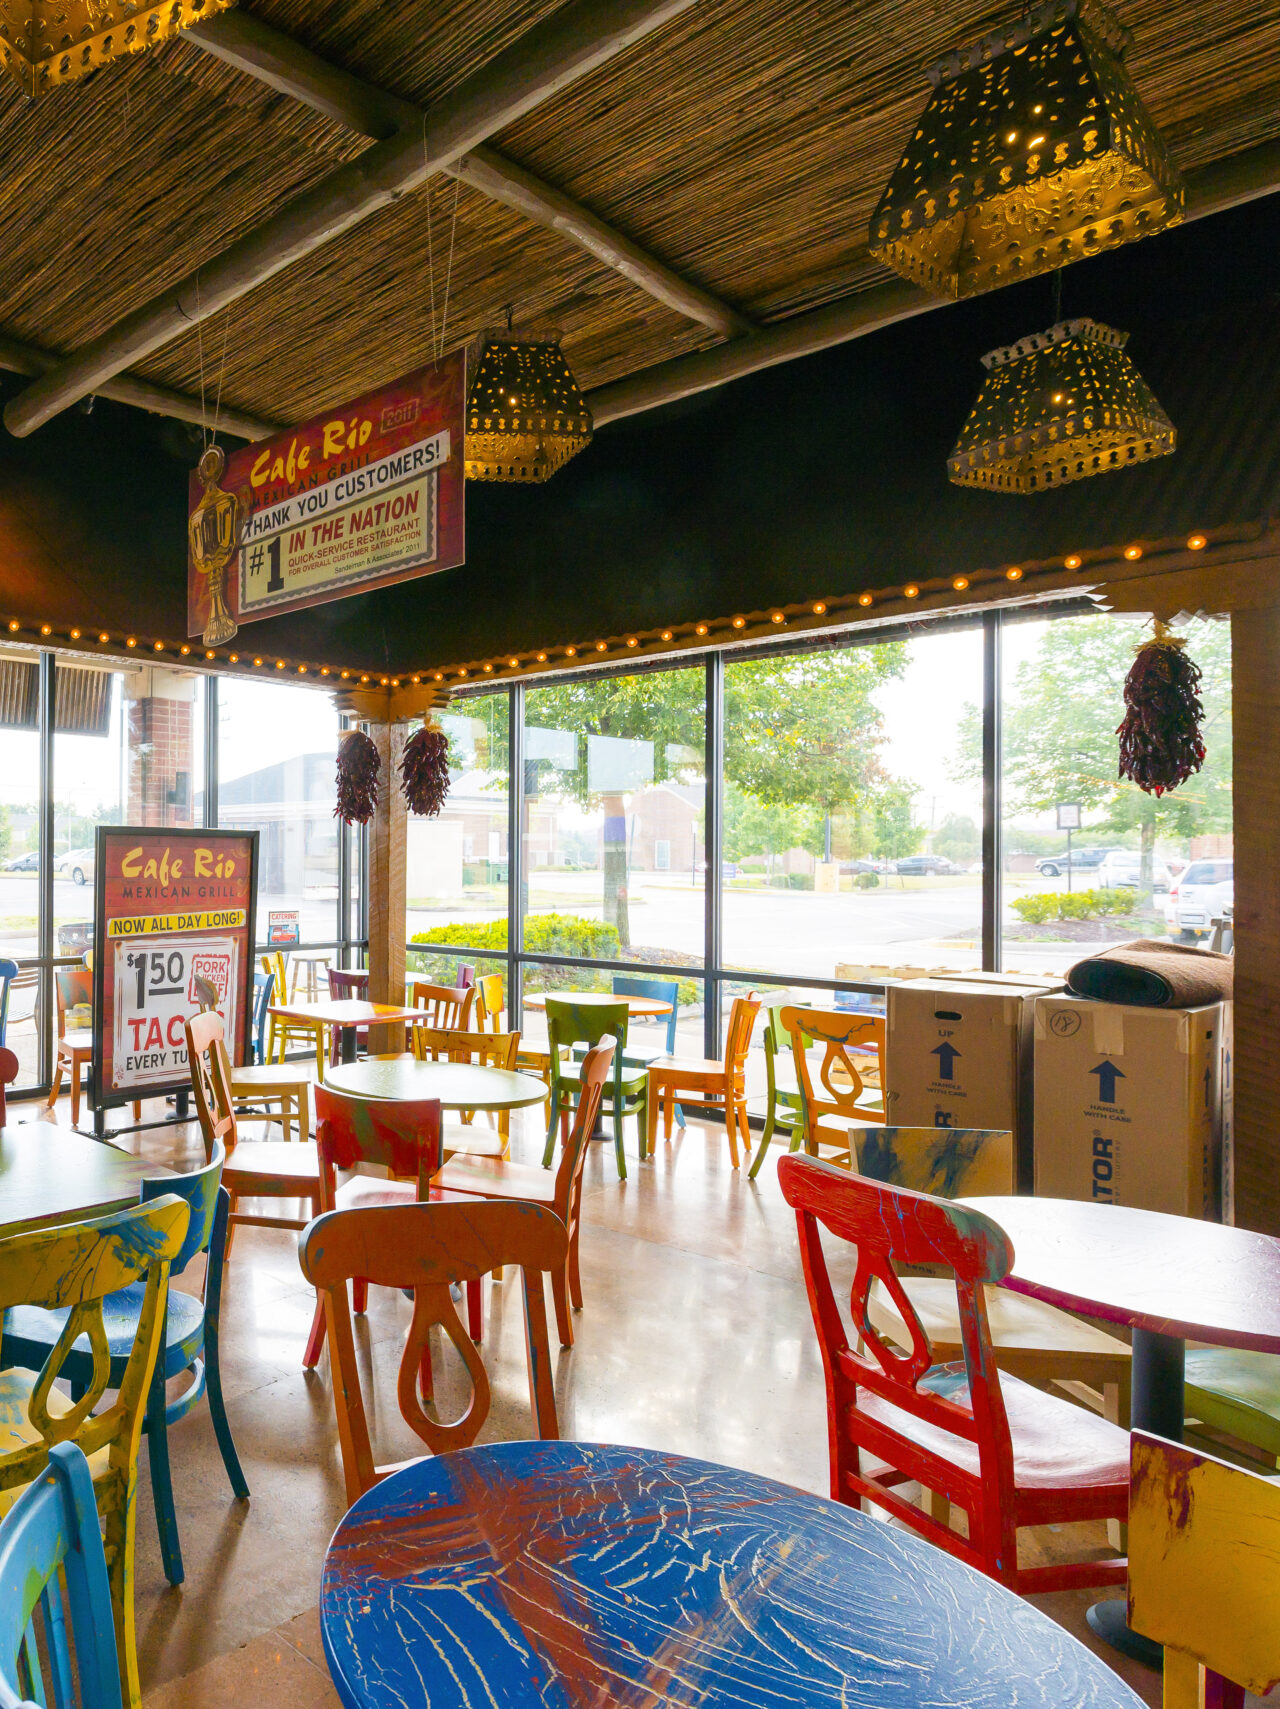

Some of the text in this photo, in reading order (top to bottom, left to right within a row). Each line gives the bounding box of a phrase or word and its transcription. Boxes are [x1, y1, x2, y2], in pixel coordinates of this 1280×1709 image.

[250, 417, 372, 488] Cafe Rio
[245, 439, 440, 538] THANK YOU CUSTOMERS!
[253, 453, 370, 506] MEXICAN GRILL
[288, 490, 419, 553] IN THE NATION
[288, 517, 420, 568] QUICK-SERVICE RESTAURANT
[288, 530, 421, 577] FOR OVERALL CUSTOMER SATISFACTION
[121, 847, 236, 887] Cafe Rio
[122, 886, 235, 899] MEXICAN GRILL
[114, 911, 240, 934] NOW ALL DAY LONG!
[195, 961, 226, 973] PORK
[126, 1052, 167, 1071] EVERY
[926, 1087, 968, 1098] WITH CARE
[931, 1081, 962, 1090] HANDLE
[1083, 1110, 1132, 1123] WITH CARE
[1090, 1104, 1125, 1115] HANDLE
